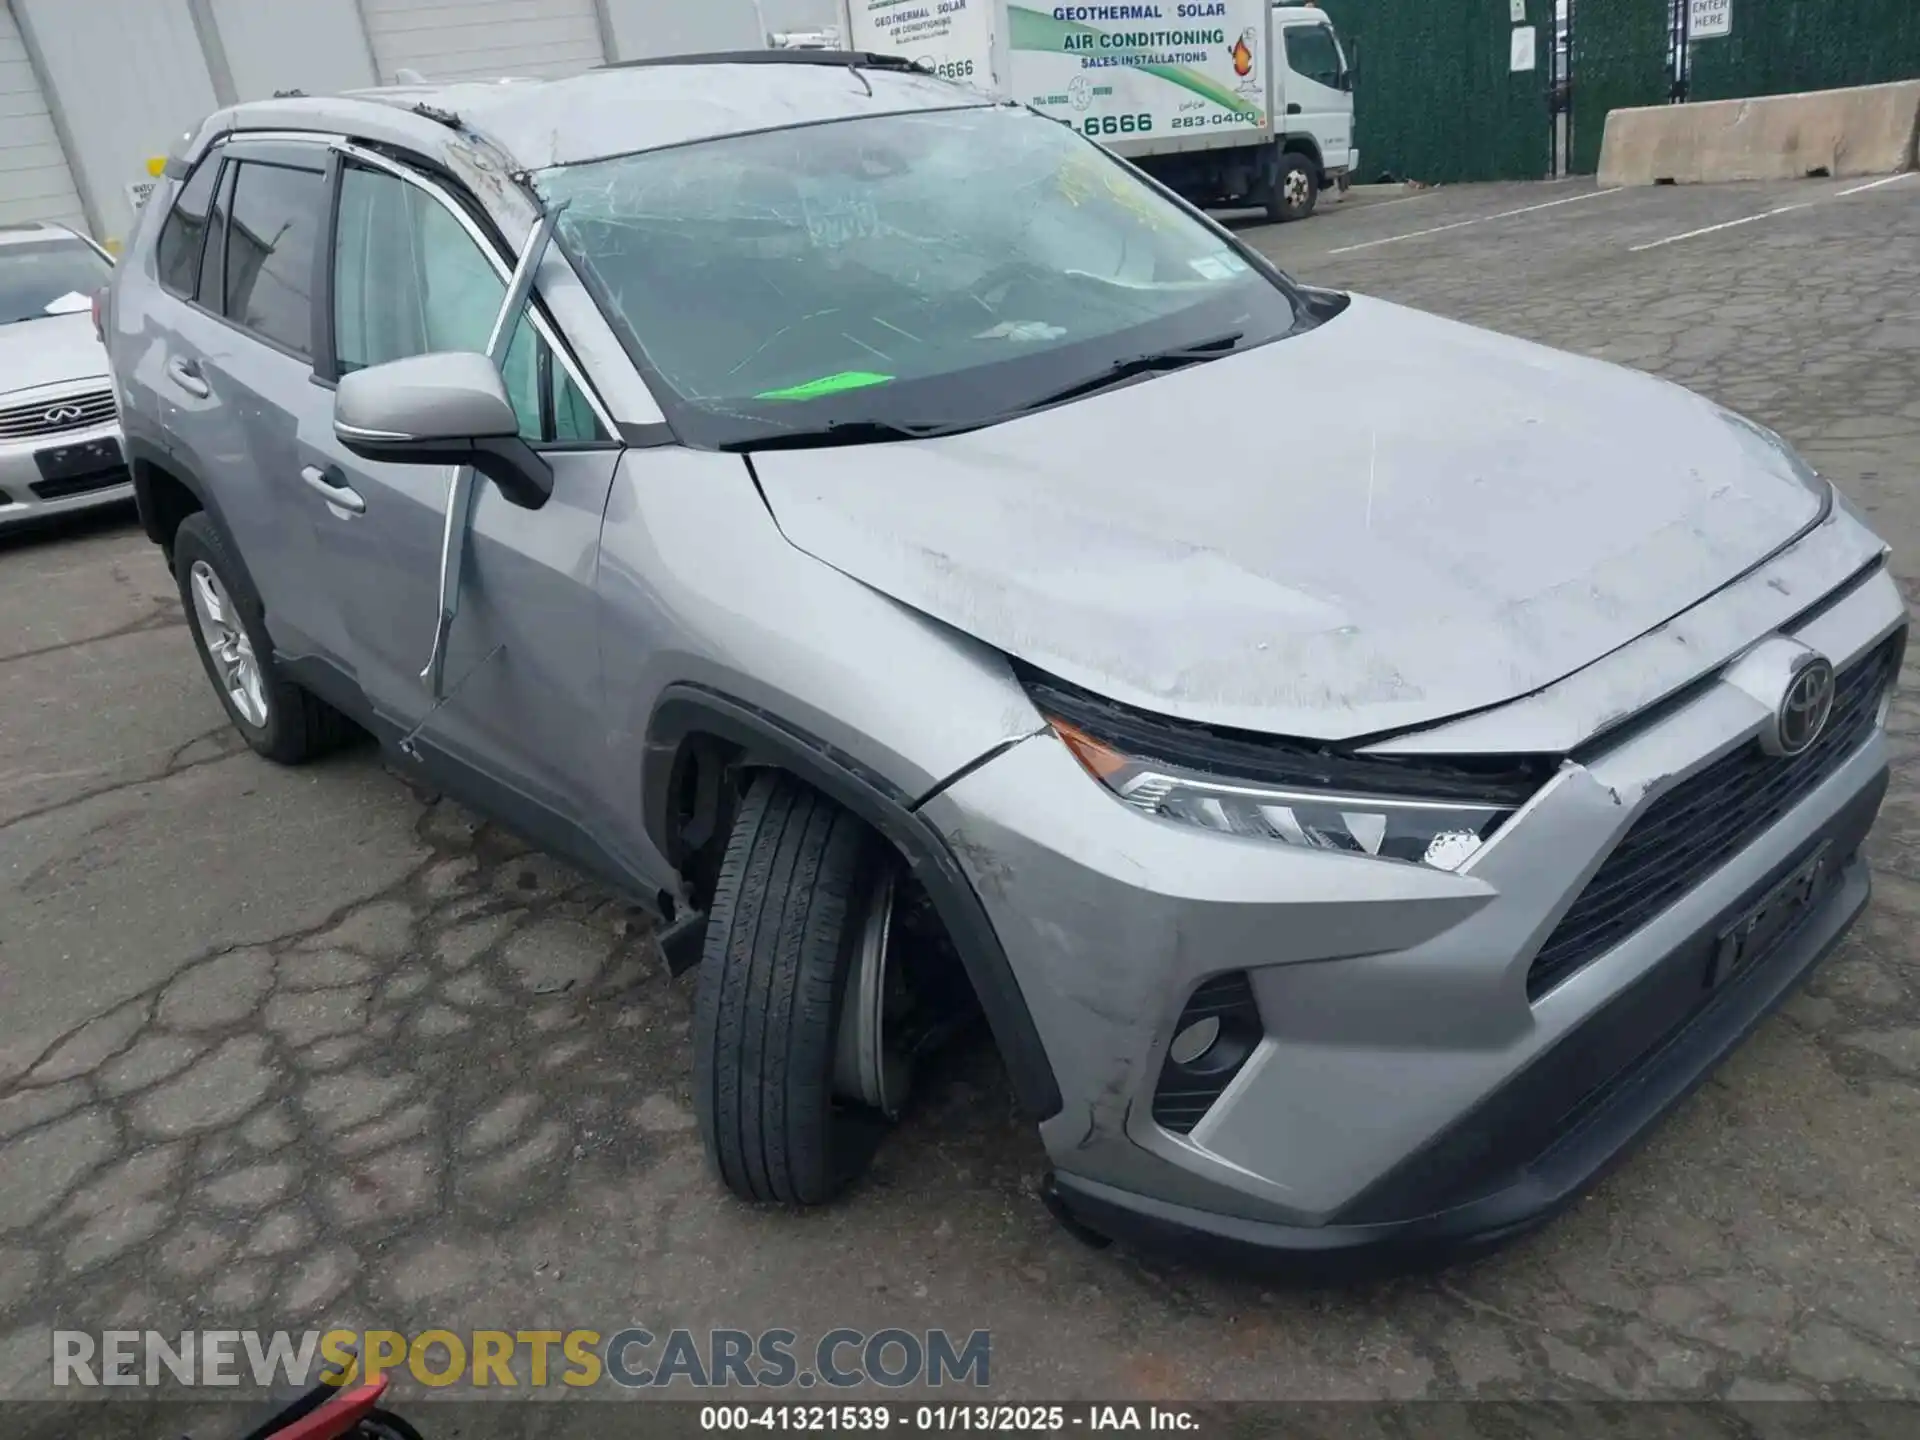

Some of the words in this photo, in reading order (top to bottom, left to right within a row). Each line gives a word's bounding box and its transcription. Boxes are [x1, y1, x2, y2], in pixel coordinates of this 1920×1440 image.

[1053, 5, 1163, 21] GEOTHERMAL
[1177, 3, 1226, 17] SOLAR
[1692, 0, 1728, 13] ENTER
[874, 8, 930, 28] GEOTHERMAL
[1694, 13, 1724, 28] HERE
[1063, 34, 1094, 49] AIR
[1099, 29, 1225, 48] CONDITIONING
